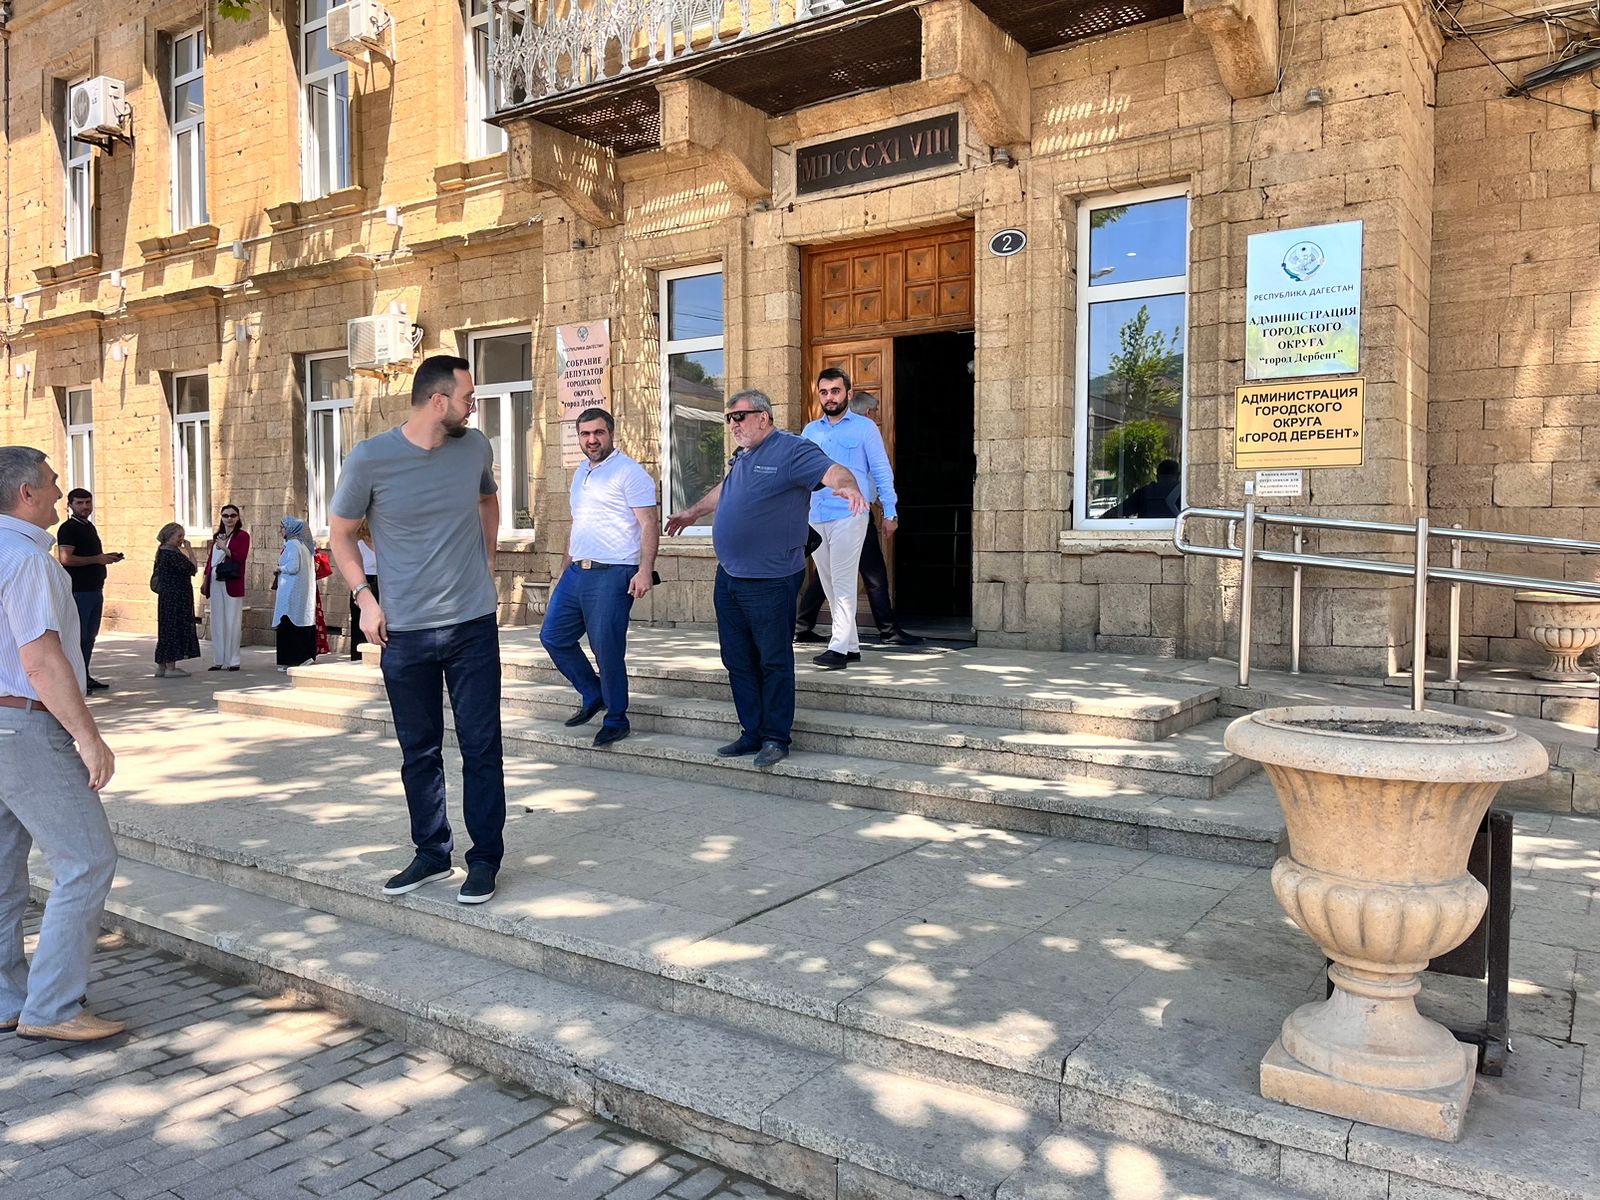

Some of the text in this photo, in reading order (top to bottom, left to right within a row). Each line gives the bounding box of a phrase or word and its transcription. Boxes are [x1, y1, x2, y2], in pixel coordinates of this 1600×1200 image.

[1002, 235, 1012, 252] 2
[1253, 285, 1354, 301] РЕСПУБЛИКА ДАГЕСТАН
[1249, 307, 1357, 325] АДМИНИСТРАЦИЯ
[1263, 322, 1342, 338] ГОРОДСКОГО
[1277, 338, 1324, 350] ОКРУГА
[566, 357, 602, 368] СОБРАНИЕ
[564, 368, 604, 379] ДЕПУТАТОВ
[567, 379, 601, 388] ГОРОДСКОГО
[1241, 387, 1358, 405] АДМИНИСТРАЦИЯ
[1255, 402, 1343, 416] ГОРОДСКОГО
[1273, 416, 1322, 428] ОКРУГА
[1238, 428, 1359, 443] «ГОРОД ДЕРБЕНТ»
